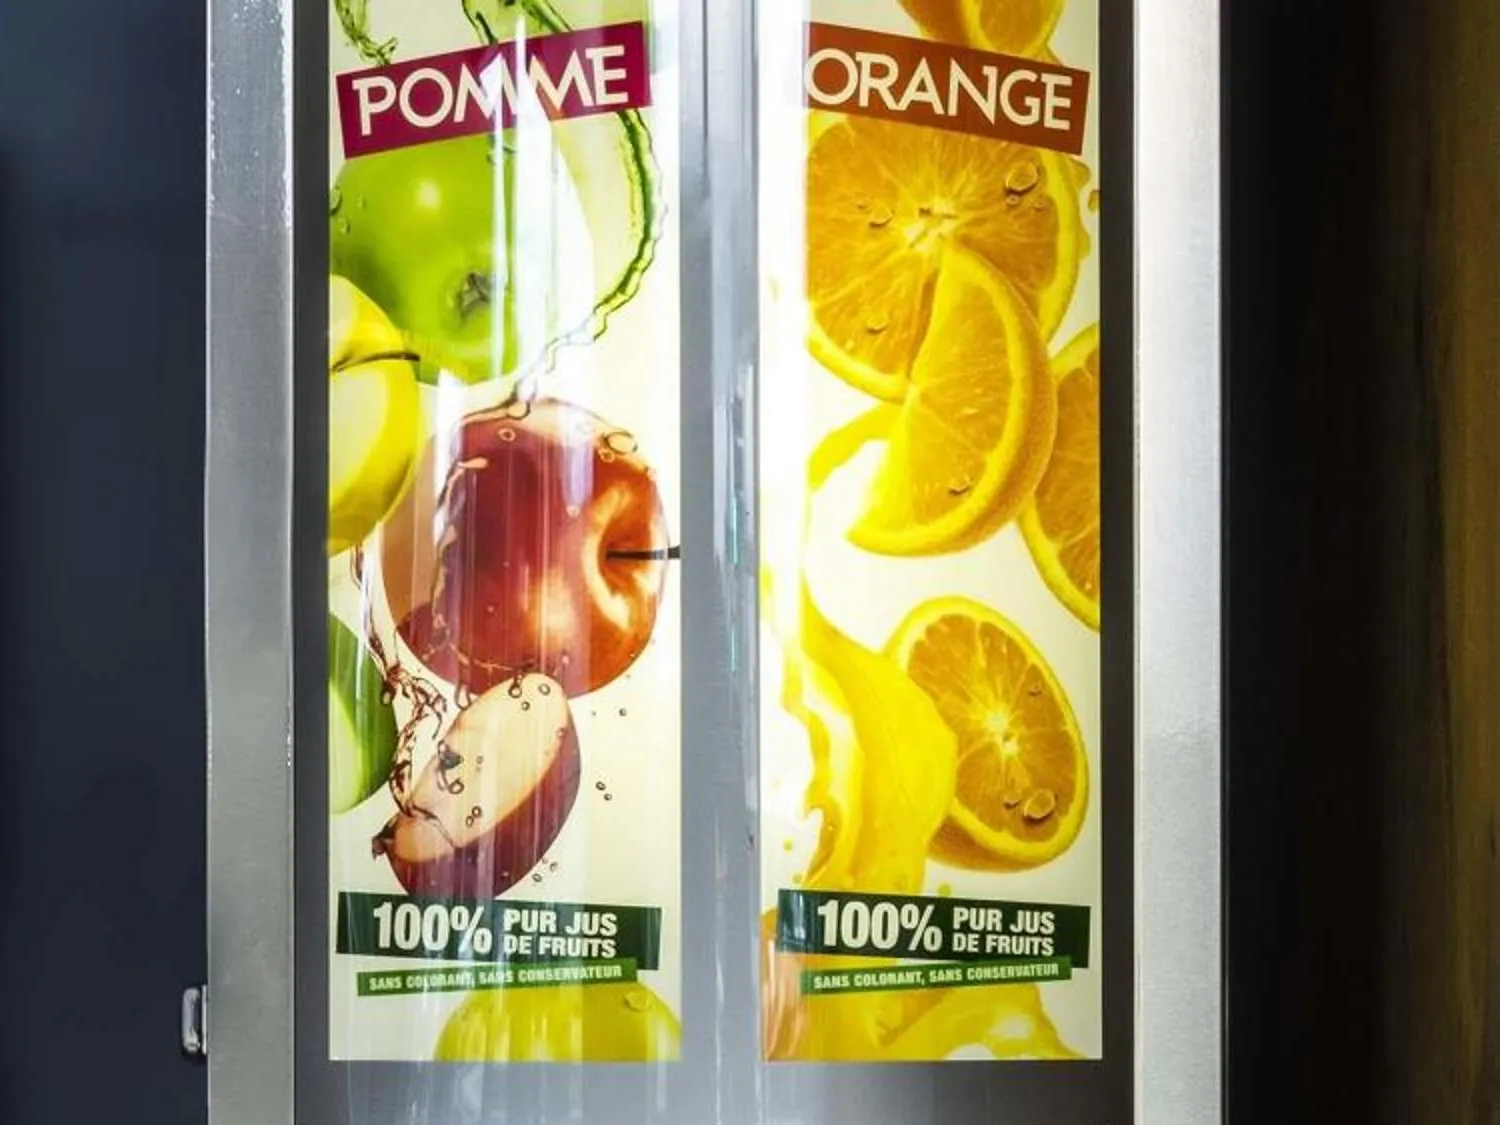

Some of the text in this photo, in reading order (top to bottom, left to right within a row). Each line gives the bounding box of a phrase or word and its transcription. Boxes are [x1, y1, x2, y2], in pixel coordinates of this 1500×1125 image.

[352, 45, 629, 136] POMME
[803, 48, 1073, 131] ORANGE
[373, 902, 493, 954] 100%
[503, 908, 618, 937] PUR JUS
[817, 899, 943, 952] 100%
[953, 907, 1055, 934] PUR JUS
[503, 935, 618, 959] DE FRUITS
[953, 934, 1055, 957] DE FRUITS
[369, 977, 402, 991] SANS
[479, 969, 513, 985] SANS
[518, 965, 622, 982] CONSERVATEUR
[813, 975, 850, 989] SANS
[929, 969, 963, 982] SANS
[967, 963, 1059, 980] CONSERVATEUR
